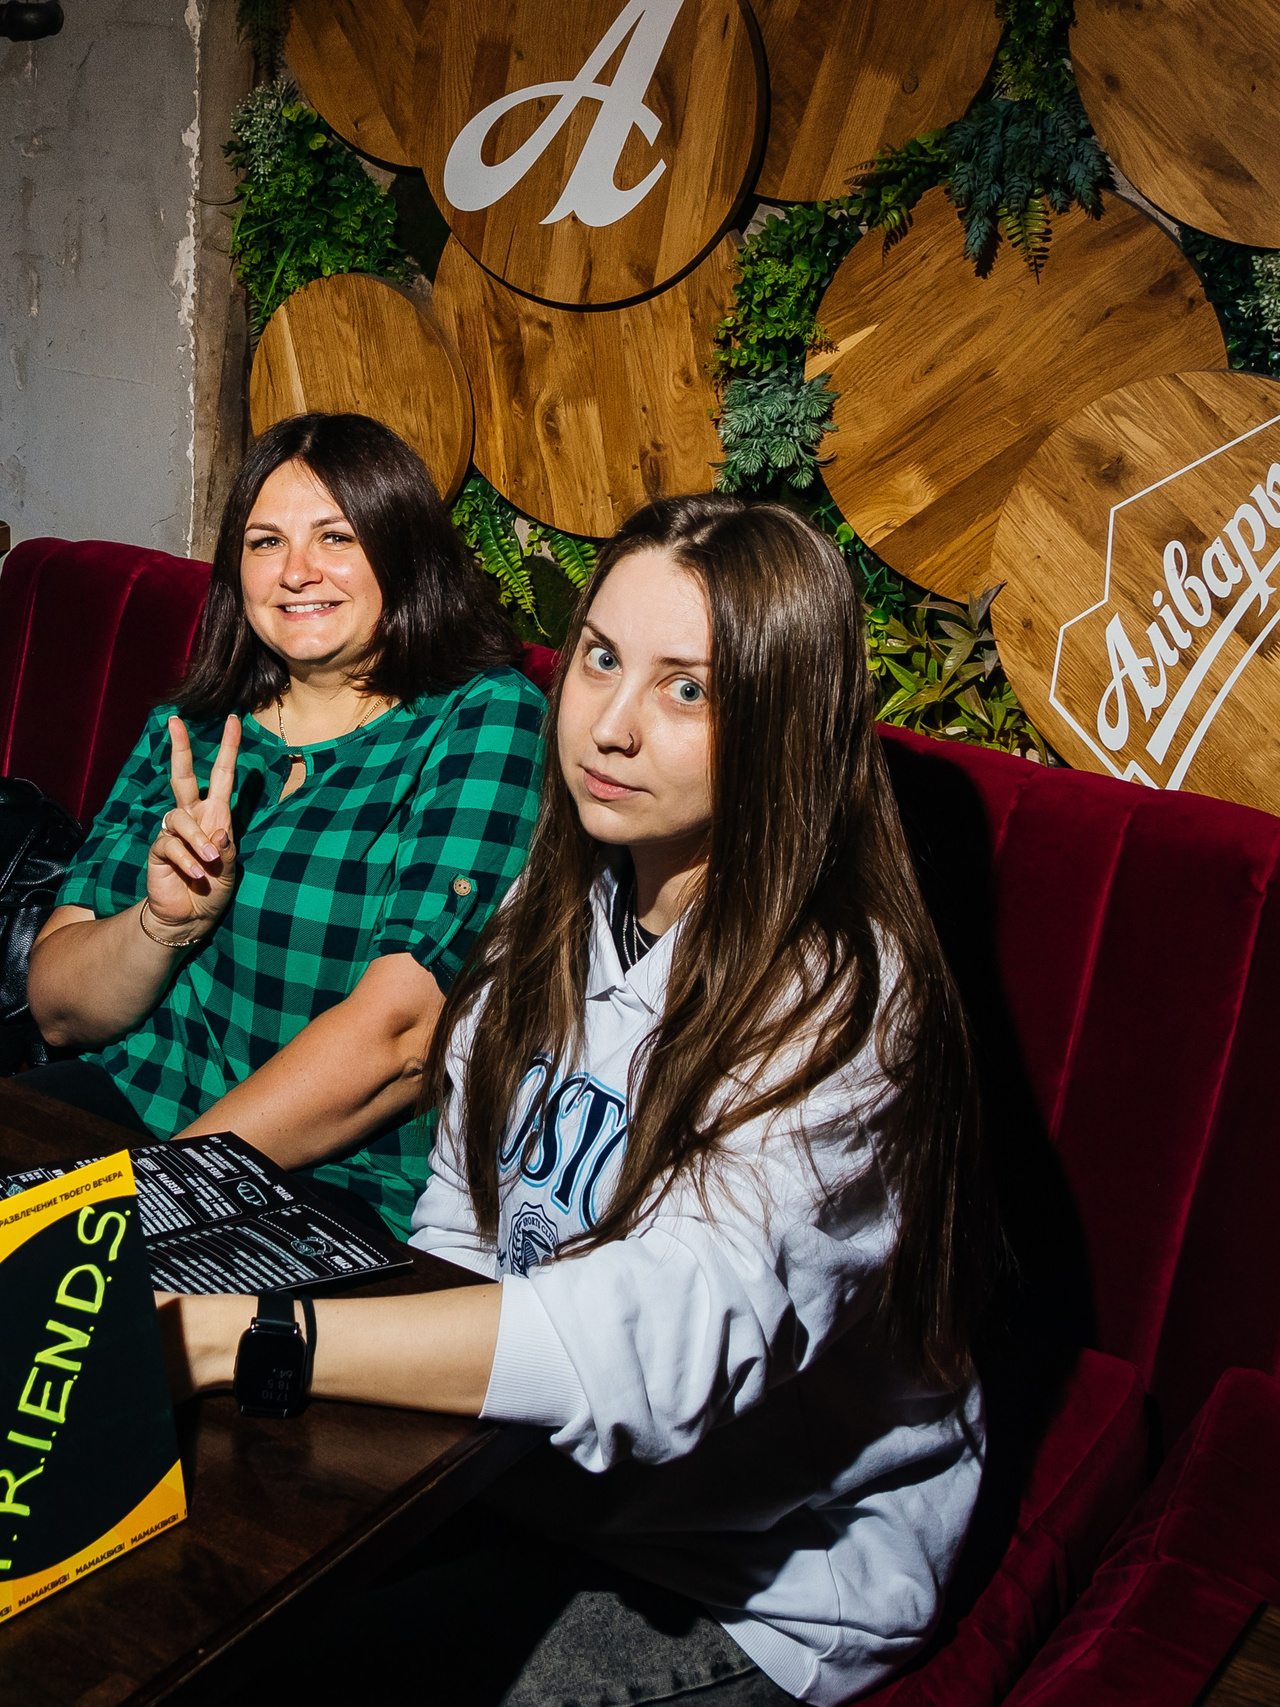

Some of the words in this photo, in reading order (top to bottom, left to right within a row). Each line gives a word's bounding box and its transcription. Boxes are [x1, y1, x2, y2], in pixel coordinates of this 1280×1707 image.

[59, 1183, 91, 1203] ТВОЕГО
[93, 1171, 124, 1188] ВЕЧЕРА
[156, 1173, 185, 1194] ДЕСЕРТЫ
[522, 1216, 540, 1229] SPORTS
[330, 1256, 352, 1269] СУПЫ
[18, 1573, 70, 1607] МАМАКВИЗ!
[75, 1542, 125, 1575] МАМАКВИЗ!
[131, 1513, 179, 1545] МАМАКВИЗ!
